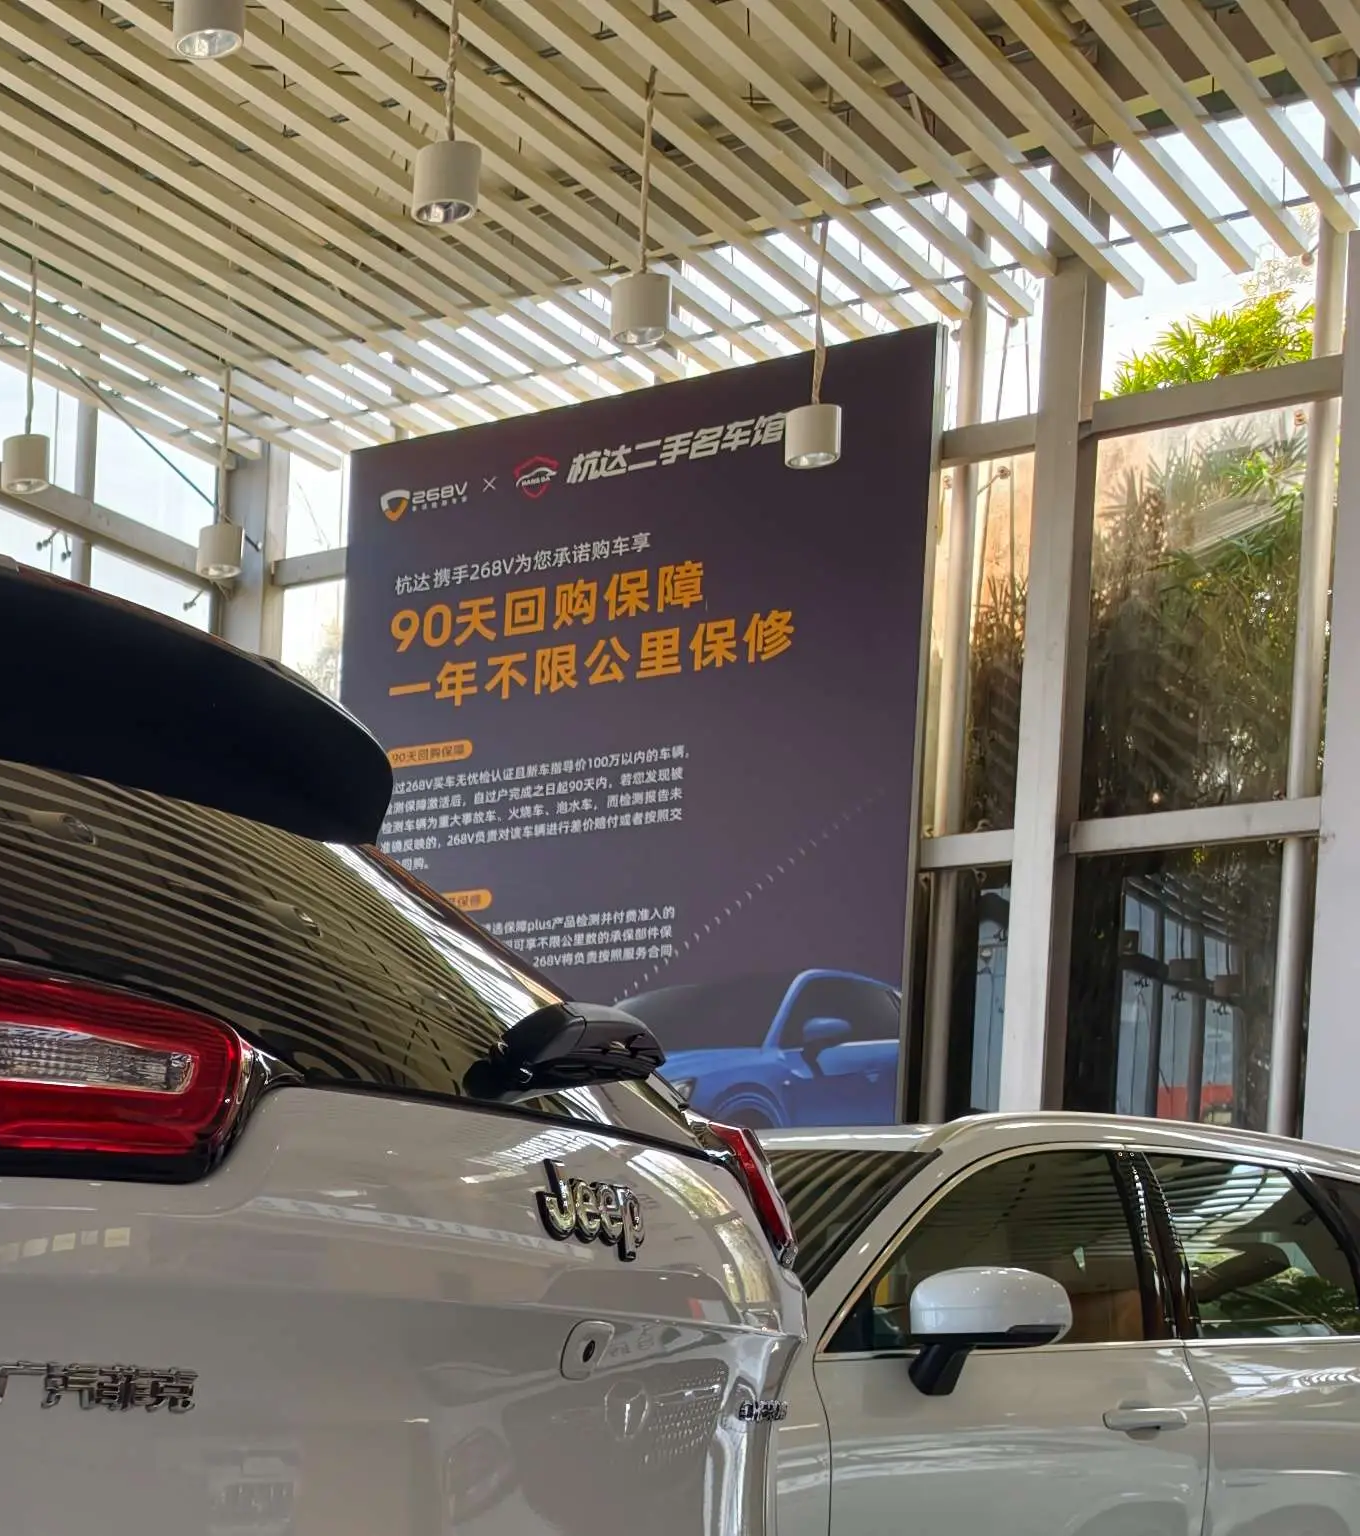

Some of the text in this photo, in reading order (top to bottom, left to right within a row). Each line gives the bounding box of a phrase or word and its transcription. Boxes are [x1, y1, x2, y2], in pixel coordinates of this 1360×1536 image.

[411, 481, 469, 504] 268V
[566, 412, 787, 484] 杭达二手名车馆
[390, 560, 705, 653] 90天回购保障
[388, 610, 796, 706] 一年不限公里保修
[535, 1158, 645, 1262] Jeep
